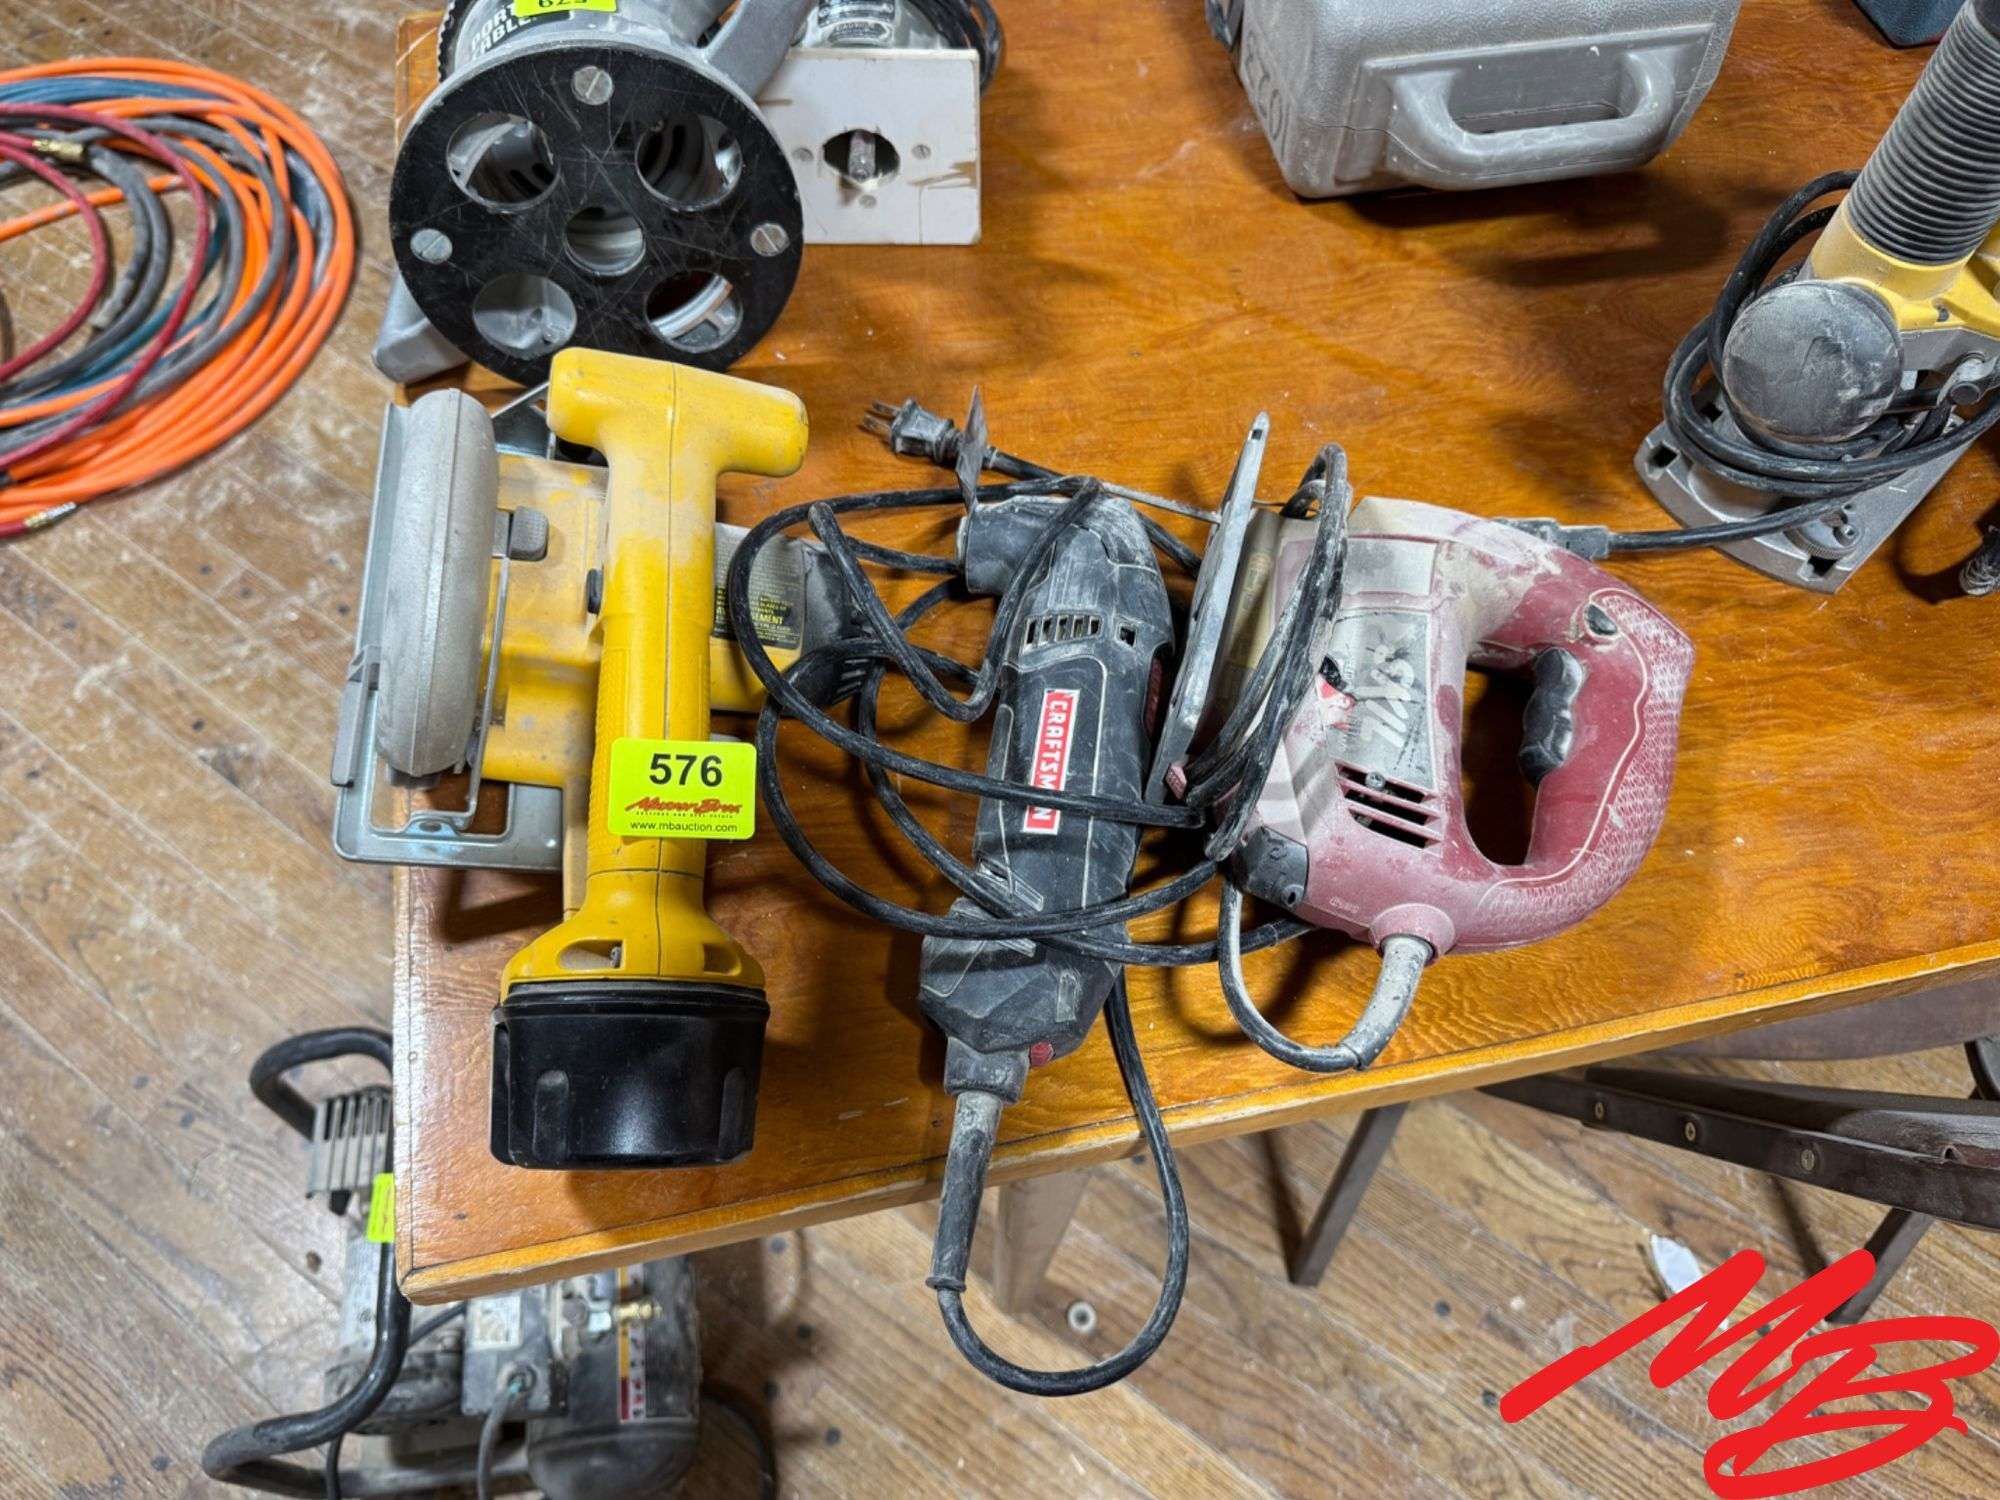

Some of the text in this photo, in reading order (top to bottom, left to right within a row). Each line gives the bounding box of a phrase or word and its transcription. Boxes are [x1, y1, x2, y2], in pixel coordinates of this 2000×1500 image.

[649, 753, 723, 787] 576
[1031, 700, 1069, 821] CRAFTSMN
[630, 820, 738, 833] www.mbauction.com
